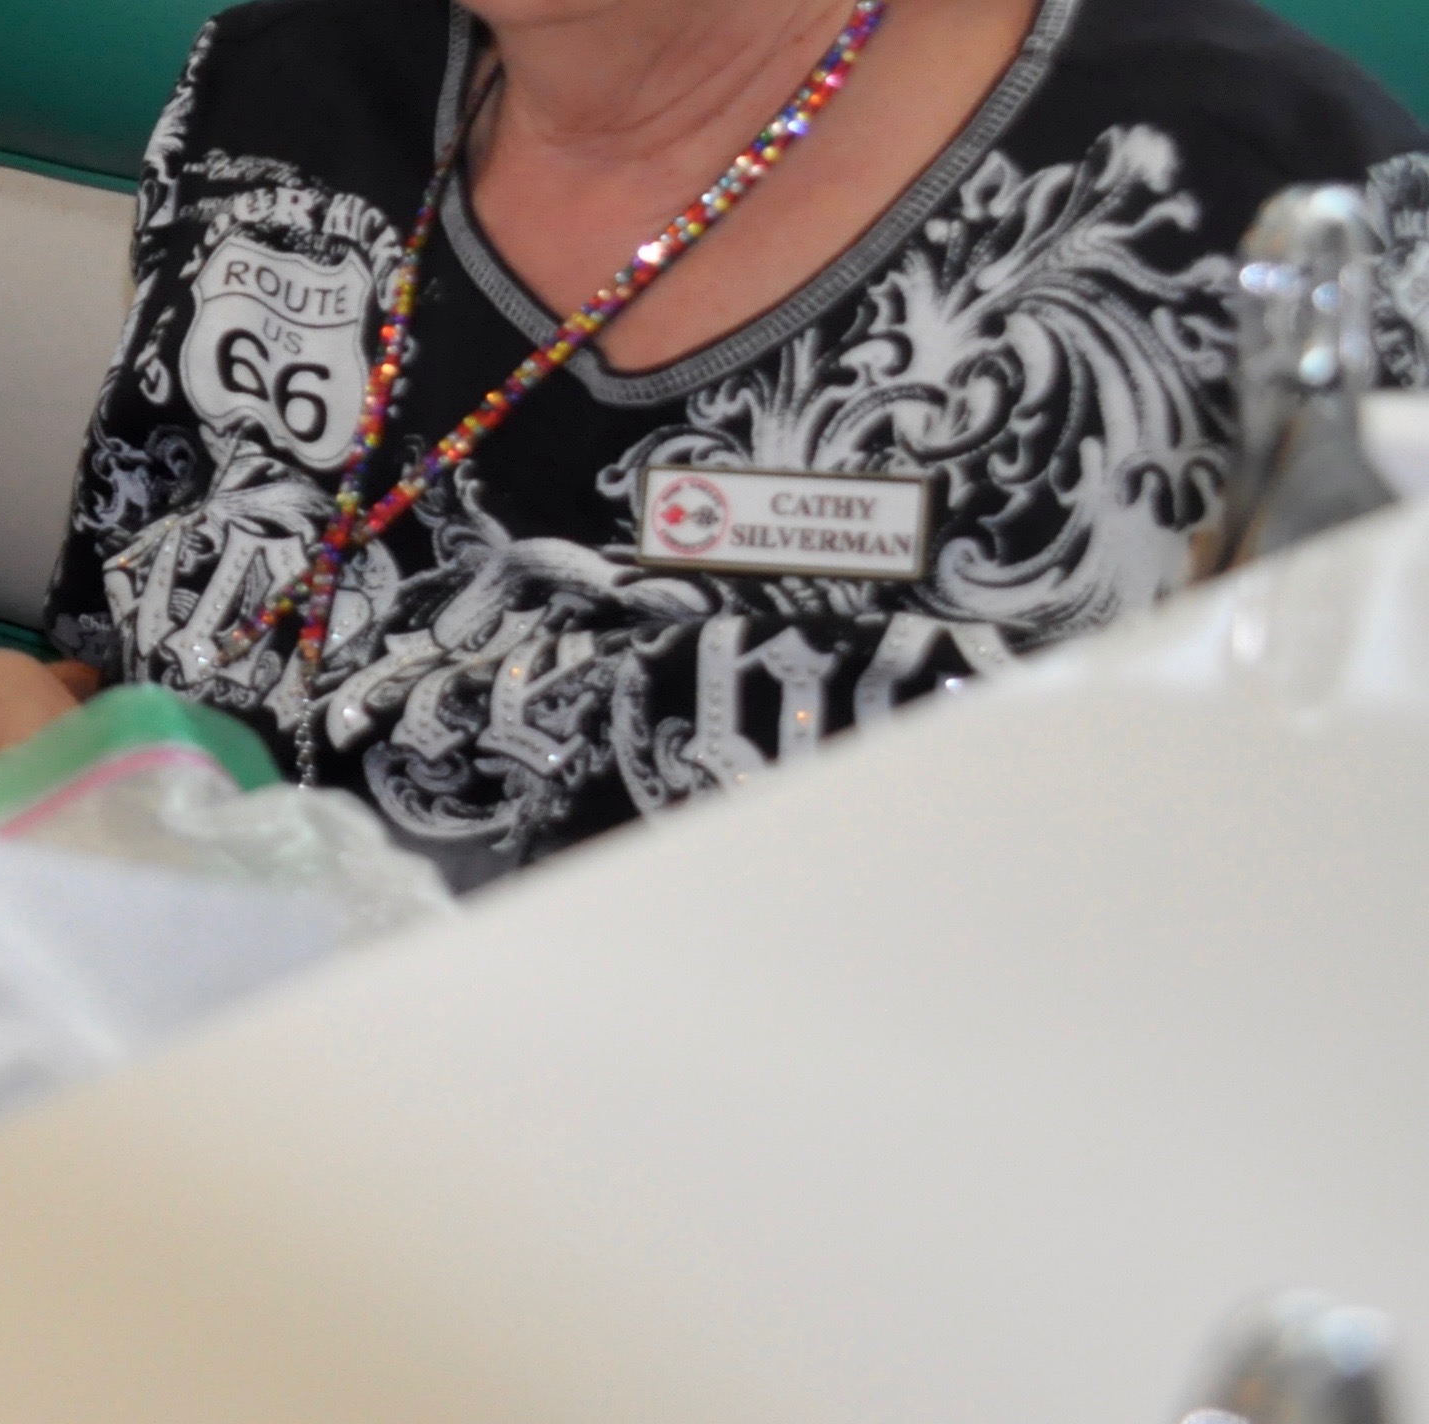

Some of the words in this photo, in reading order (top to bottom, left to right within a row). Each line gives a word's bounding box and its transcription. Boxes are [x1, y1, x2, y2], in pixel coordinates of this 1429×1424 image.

[222, 259, 348, 317] ROUTE
[260, 315, 303, 356] US
[215, 327, 332, 444] 66
[770, 492, 877, 520] CATHY
[729, 523, 914, 557] SILVERMAN
